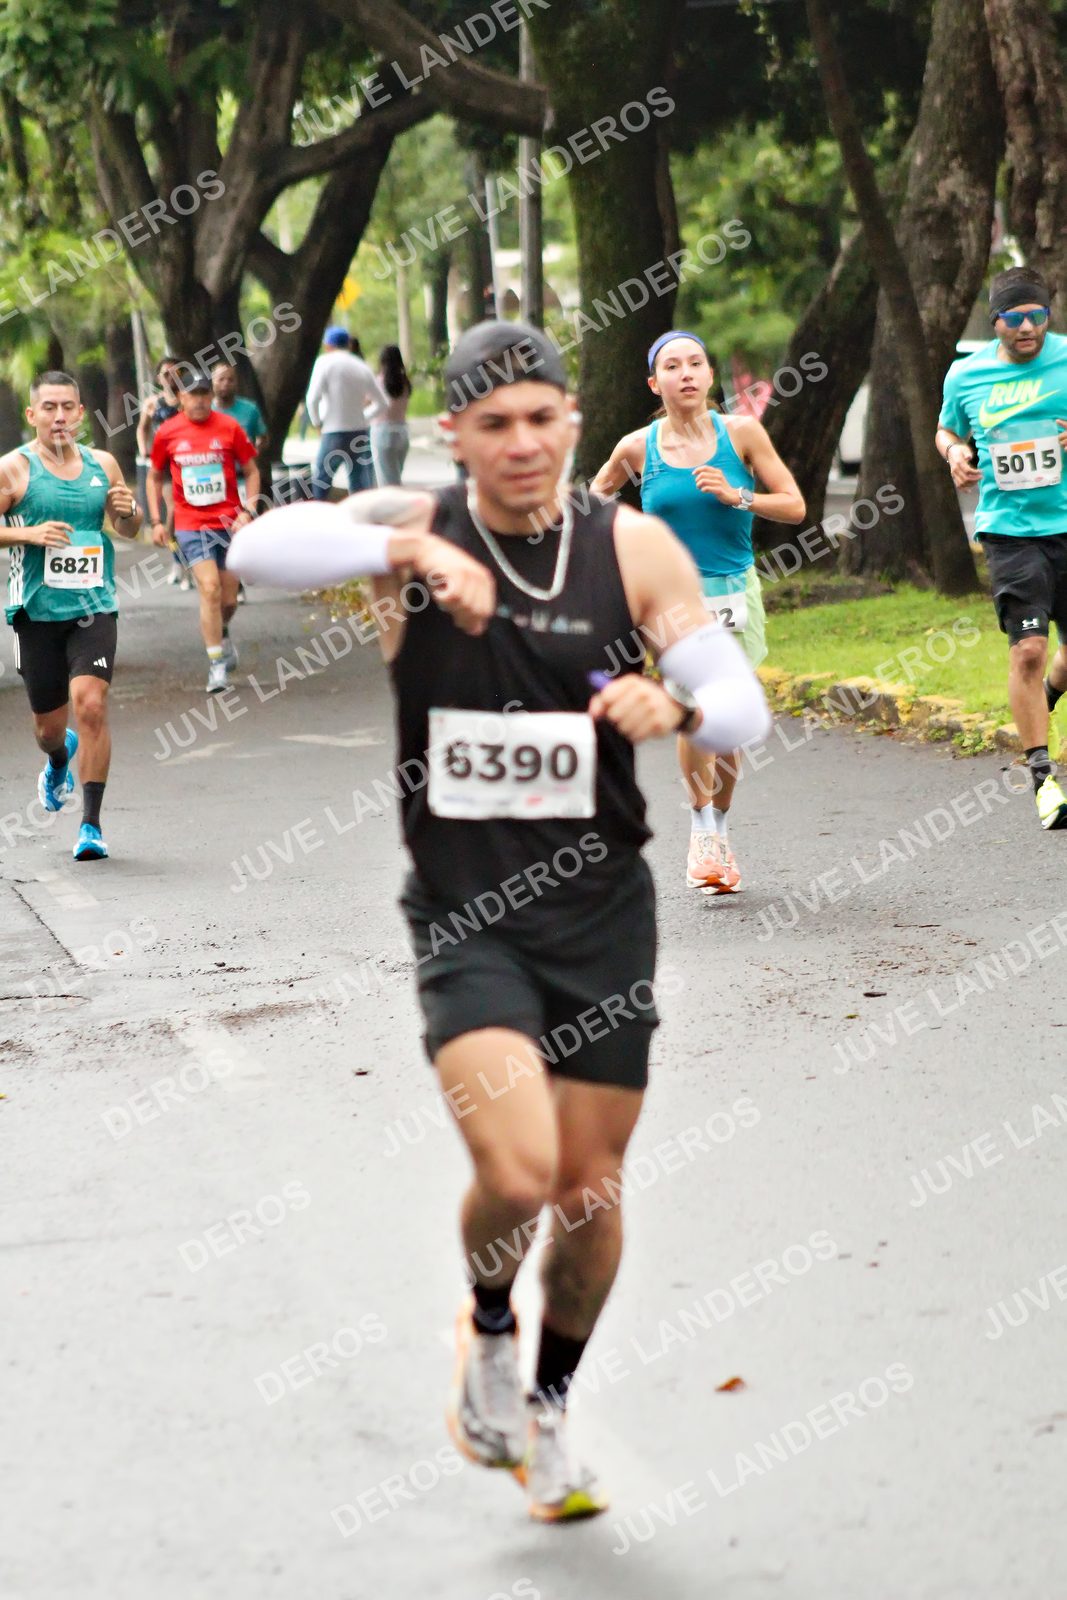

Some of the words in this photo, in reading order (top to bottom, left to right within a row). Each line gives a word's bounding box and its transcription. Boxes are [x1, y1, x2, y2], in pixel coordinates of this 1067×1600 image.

[988, 379, 1042, 407] RUN
[996, 449, 1057, 475] 5015
[187, 482, 223, 496] 3082
[50, 556, 98, 574] 6821
[445, 742, 579, 783] 6390
